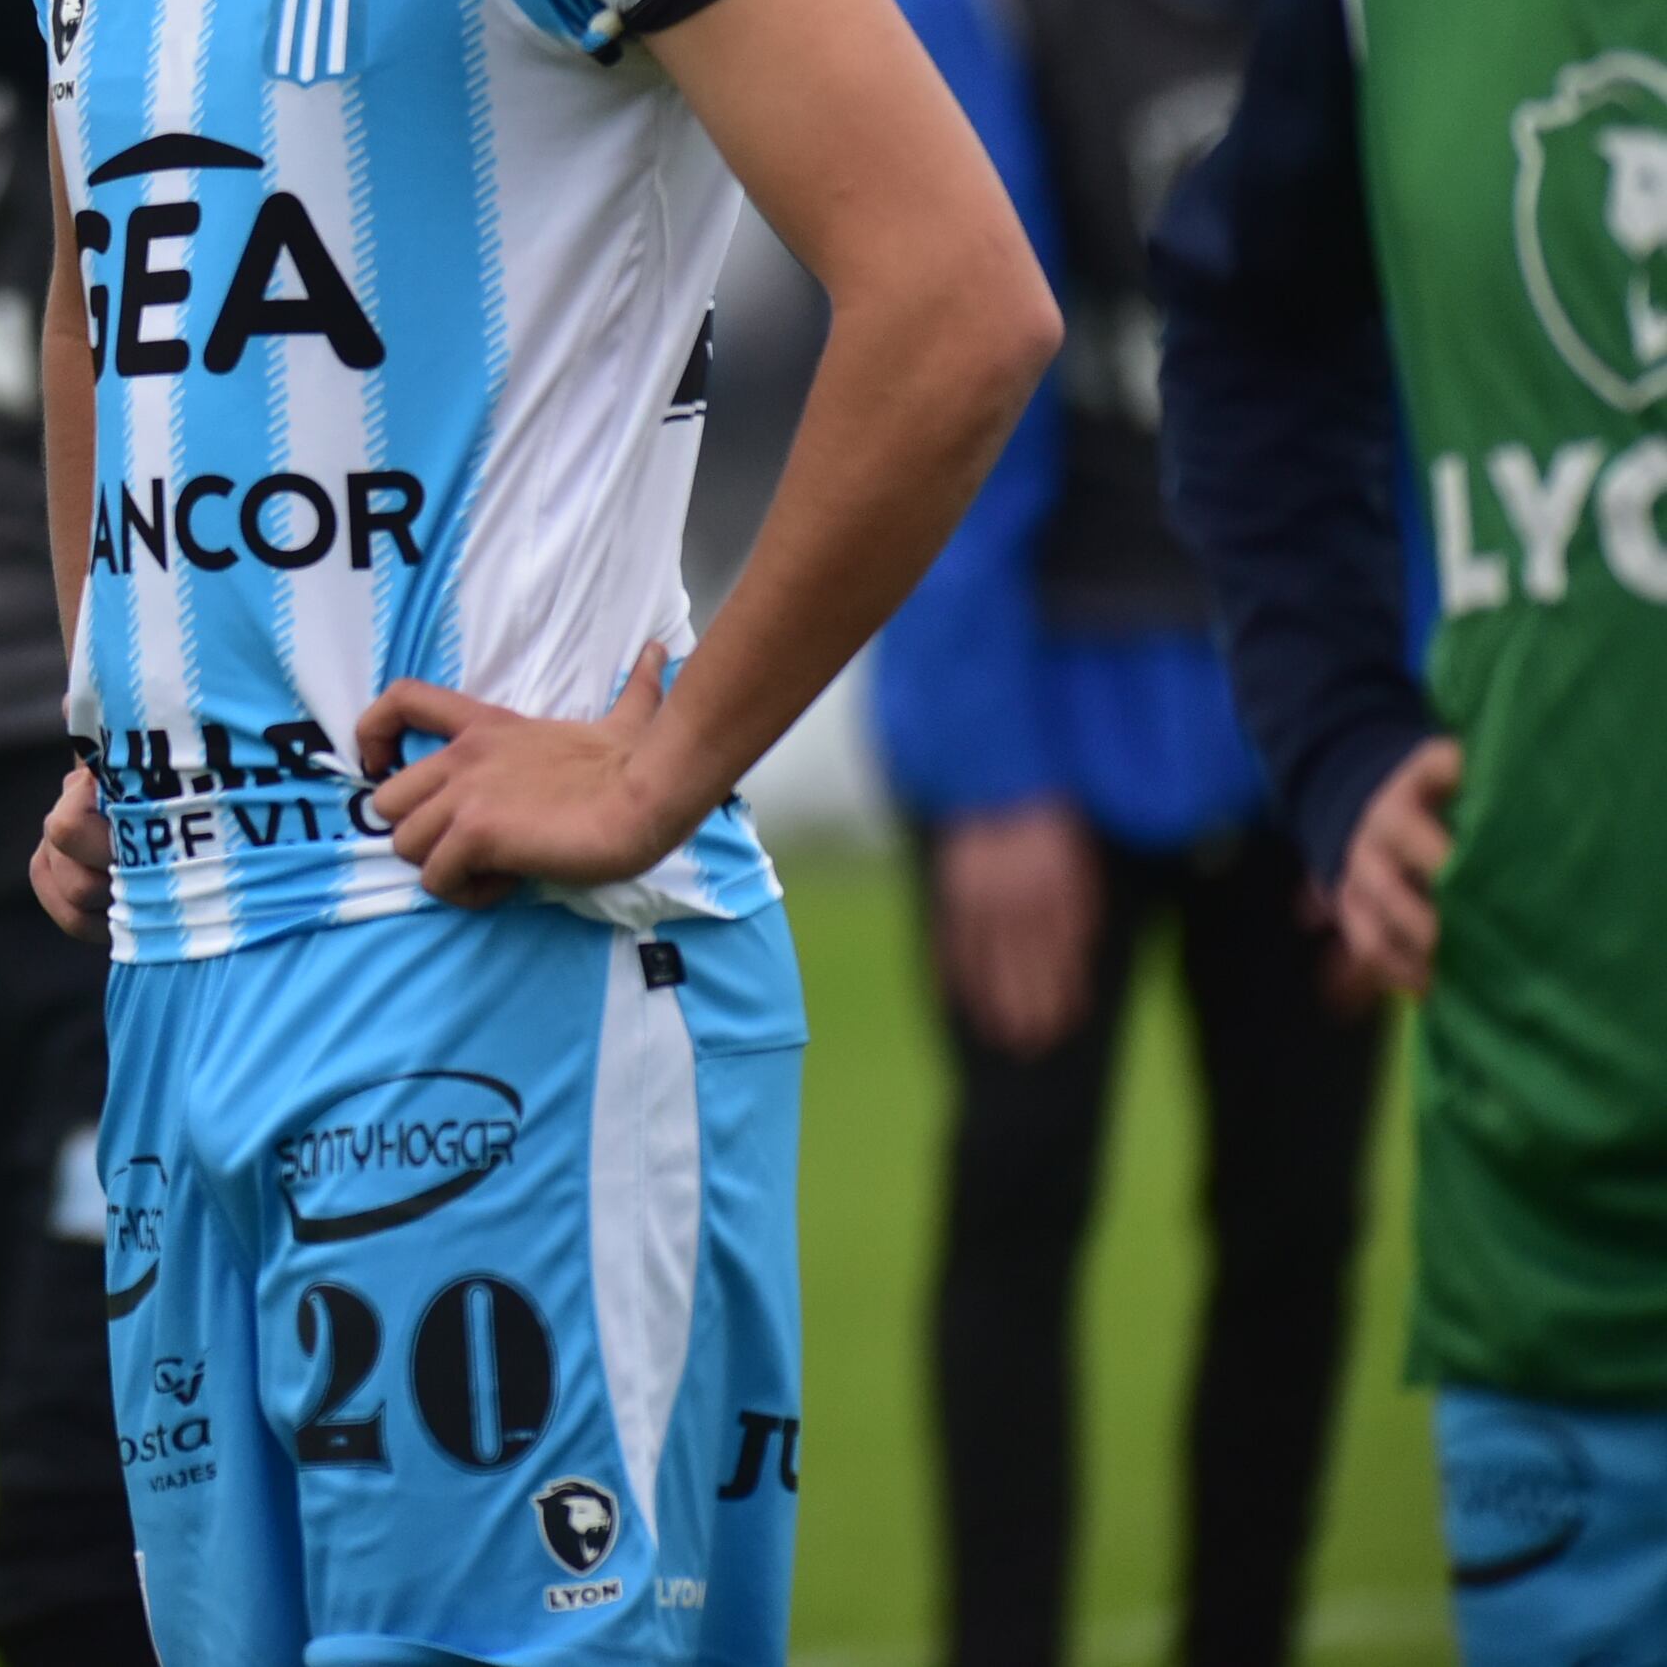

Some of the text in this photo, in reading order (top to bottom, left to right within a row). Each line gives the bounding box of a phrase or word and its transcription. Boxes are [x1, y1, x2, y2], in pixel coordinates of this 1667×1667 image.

[90, 471, 425, 575] ANCOR
[1429, 439, 1667, 619] LYO
[293, 1274, 559, 1475] 20
[120, 1417, 212, 1466] osta
[549, 1582, 619, 1610] LYON
